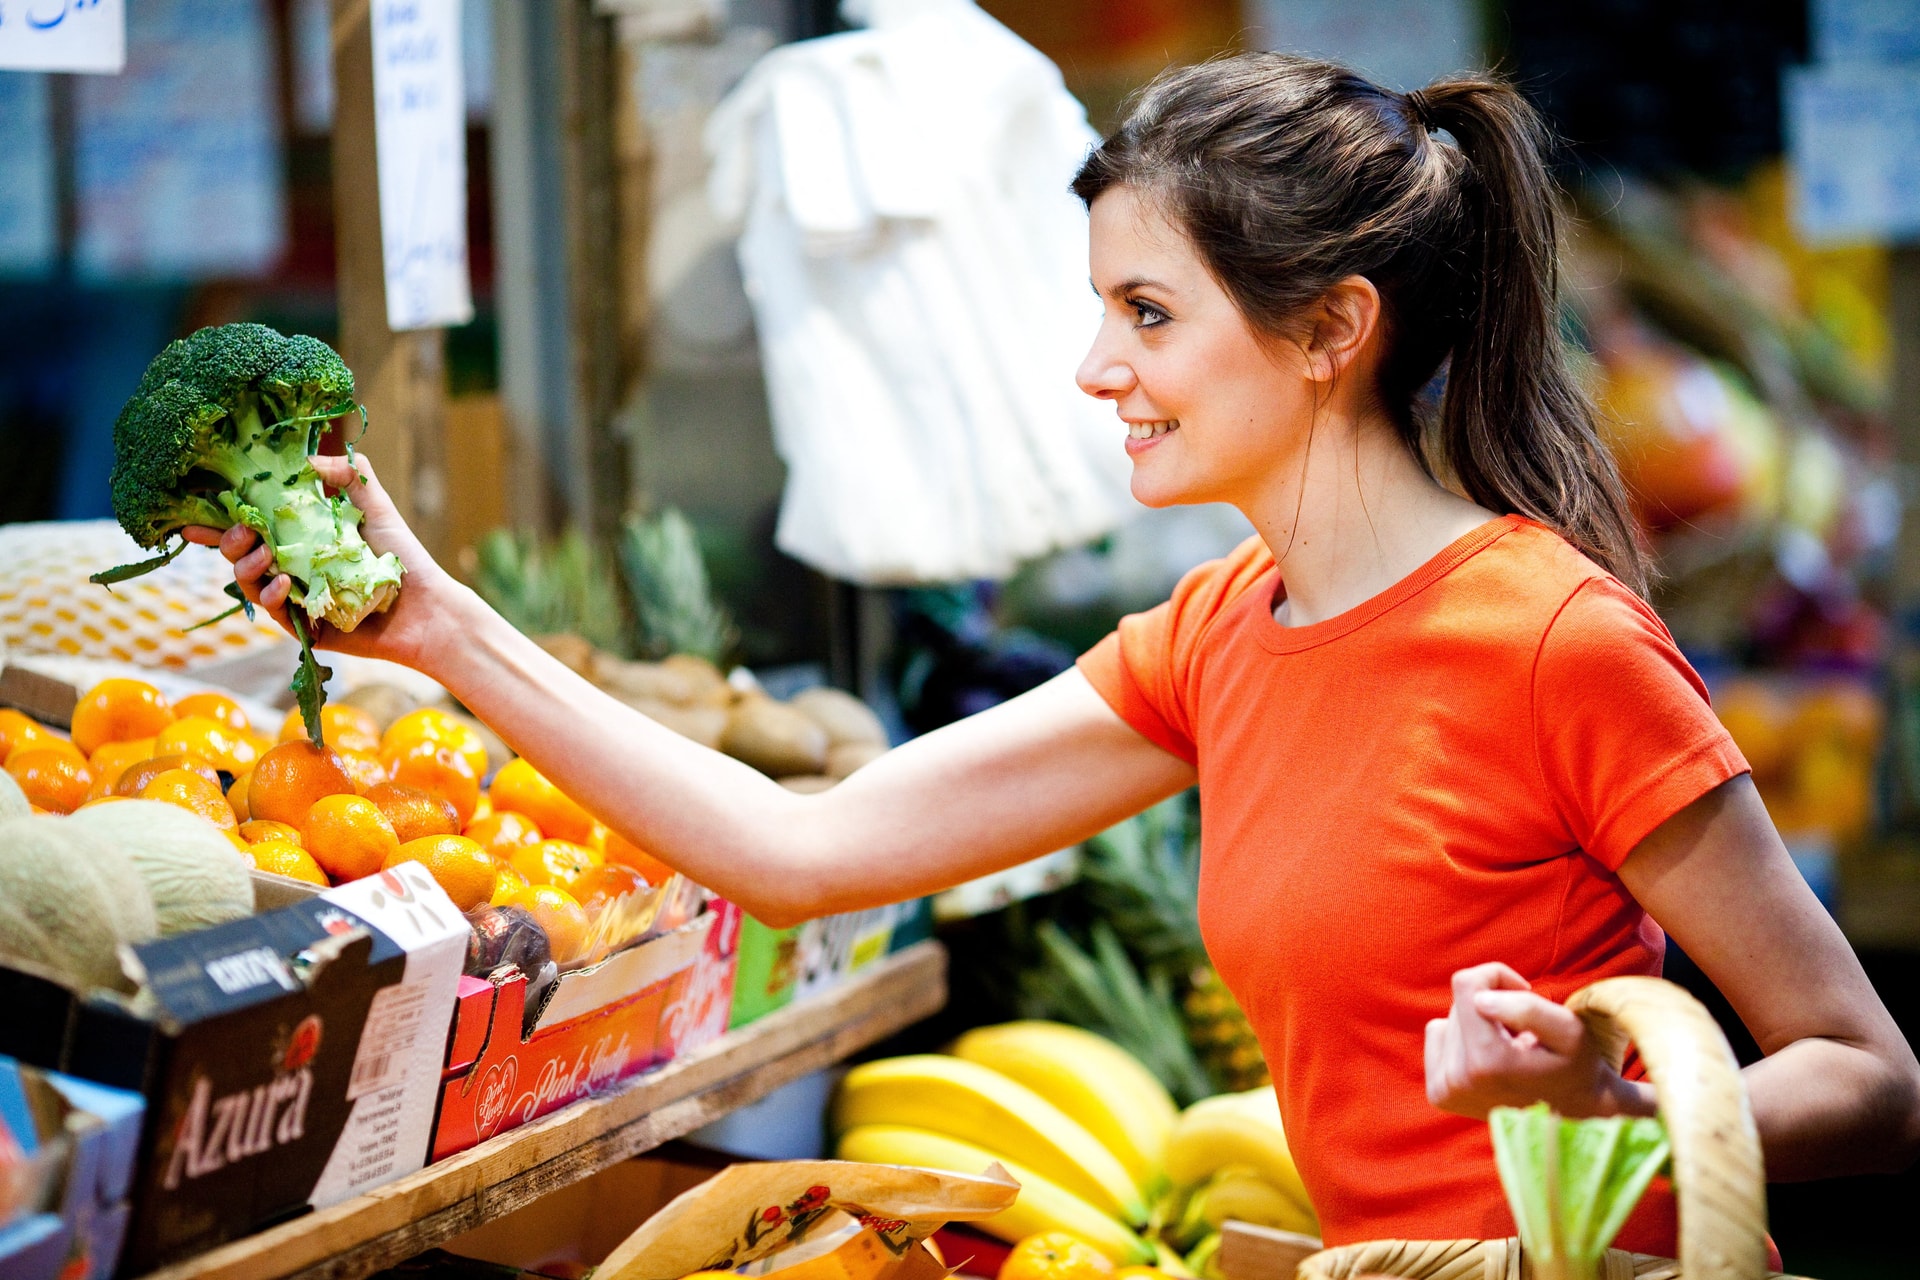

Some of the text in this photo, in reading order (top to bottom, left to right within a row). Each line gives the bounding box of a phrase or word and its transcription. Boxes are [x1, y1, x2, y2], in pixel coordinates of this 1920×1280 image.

[479, 1068, 508, 1117] Pink
[480, 1091, 507, 1132] Lady
[509, 1032, 631, 1122] Pink Lady
[164, 1067, 314, 1190] Azura
